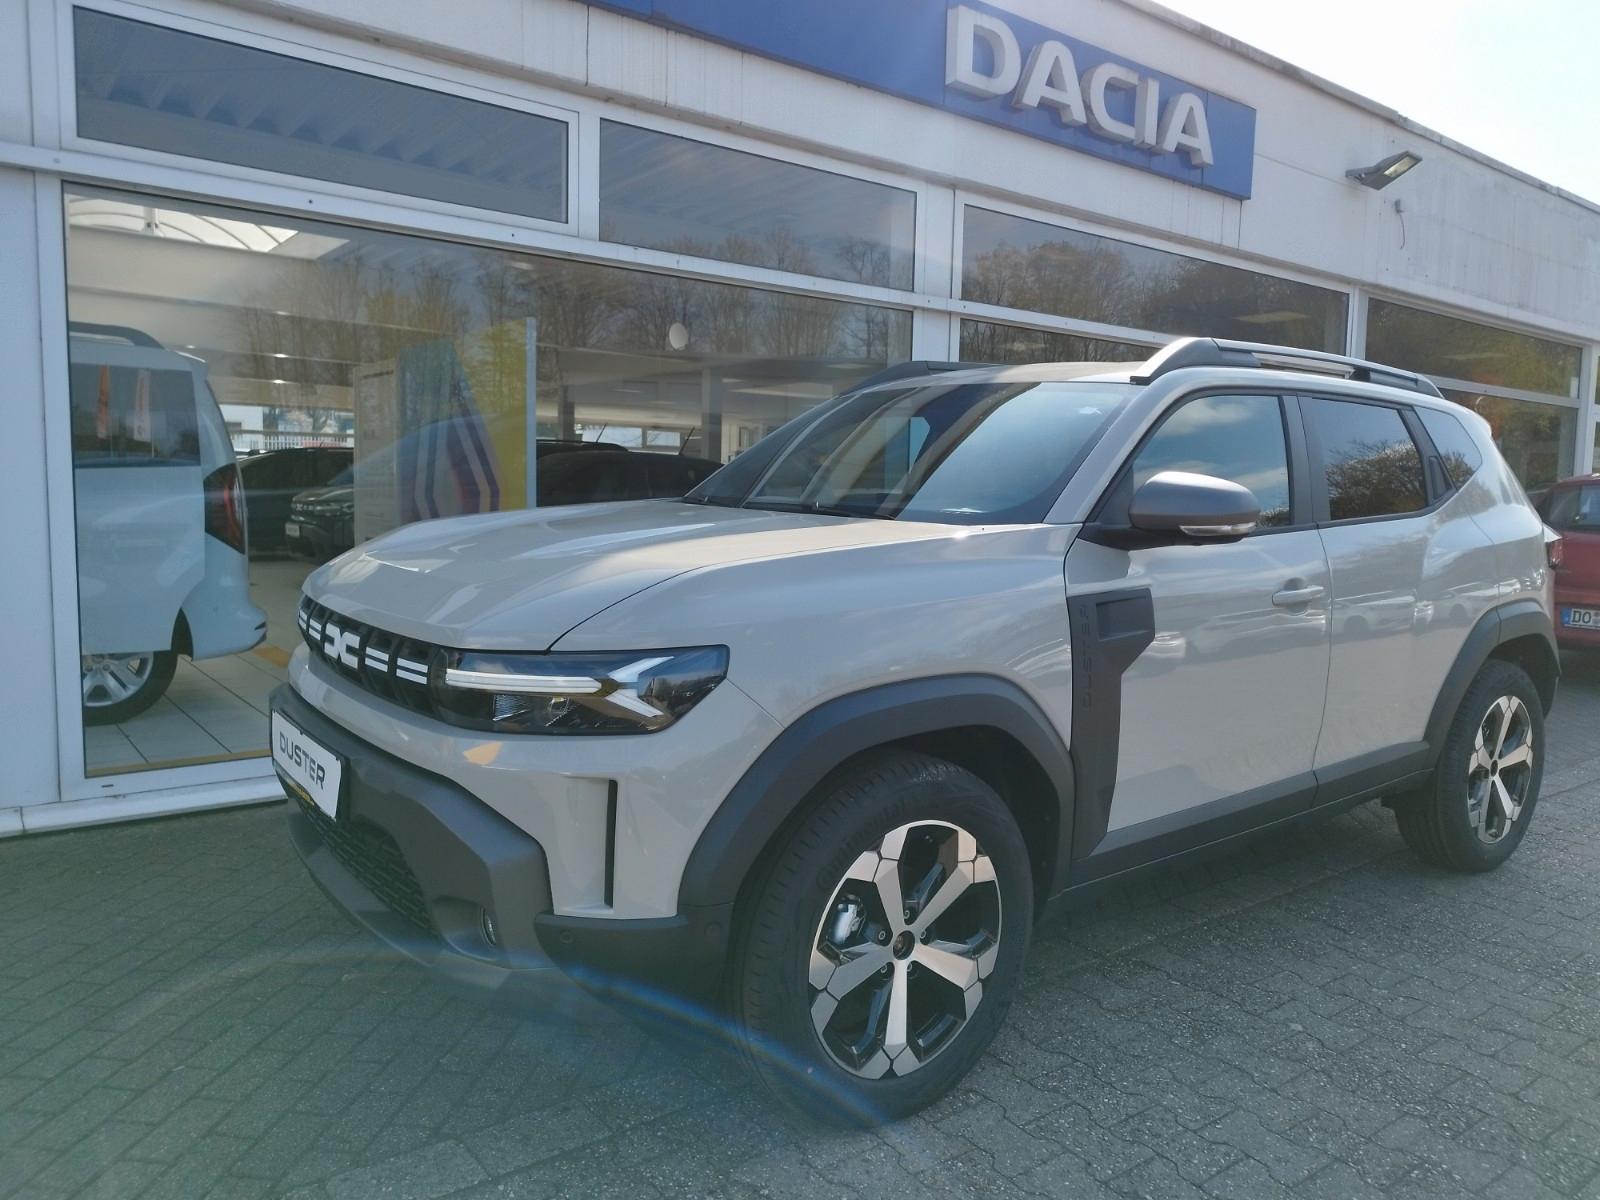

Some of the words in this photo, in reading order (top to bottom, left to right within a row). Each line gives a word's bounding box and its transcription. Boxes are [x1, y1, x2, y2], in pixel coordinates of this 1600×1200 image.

[945, 5, 1214, 168] DACIA
[1571, 610, 1592, 624] DO
[279, 731, 326, 790] DUSTER
